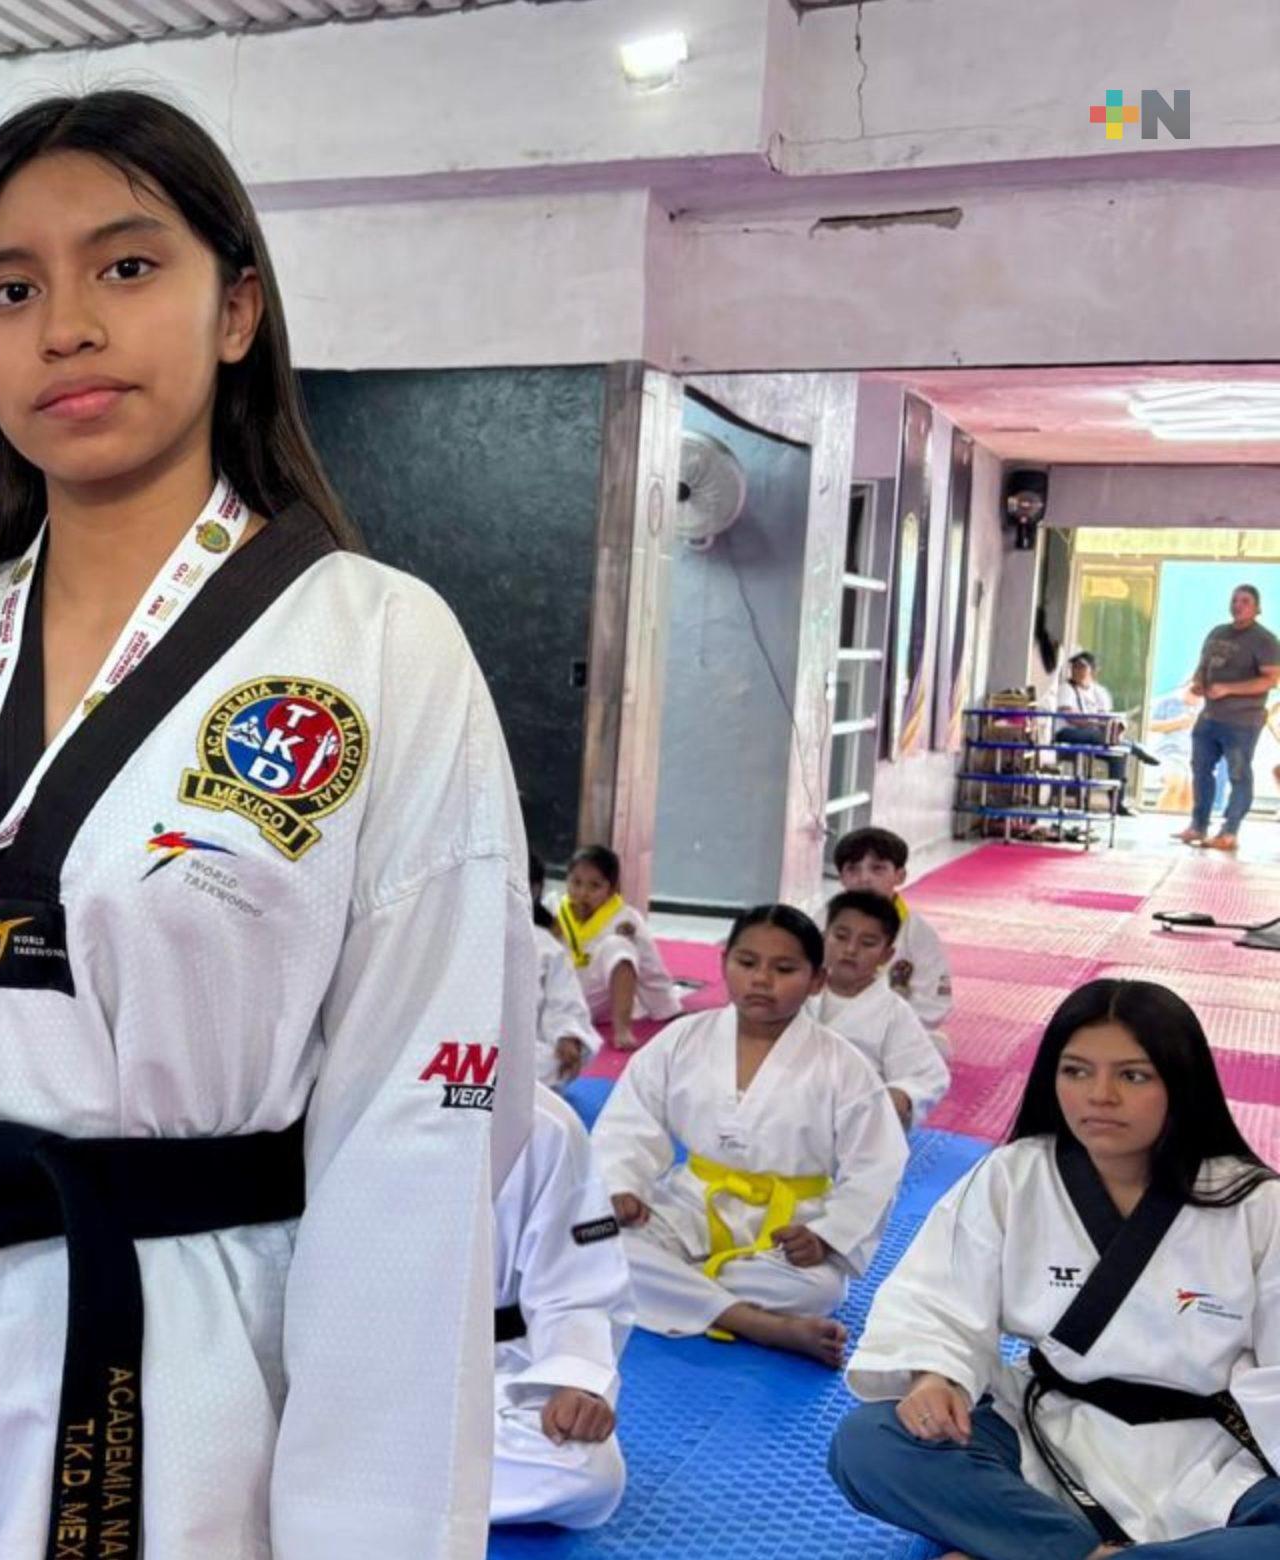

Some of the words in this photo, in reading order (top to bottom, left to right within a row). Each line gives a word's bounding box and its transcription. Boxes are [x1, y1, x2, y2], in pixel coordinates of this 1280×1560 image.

[207, 683, 273, 756] ACADEMIA
[247, 703, 318, 789] TKD
[310, 716, 361, 809] NACIONAL
[102, 1366, 135, 1511] ACADEMIA
[98, 1519, 131, 1560] NA
